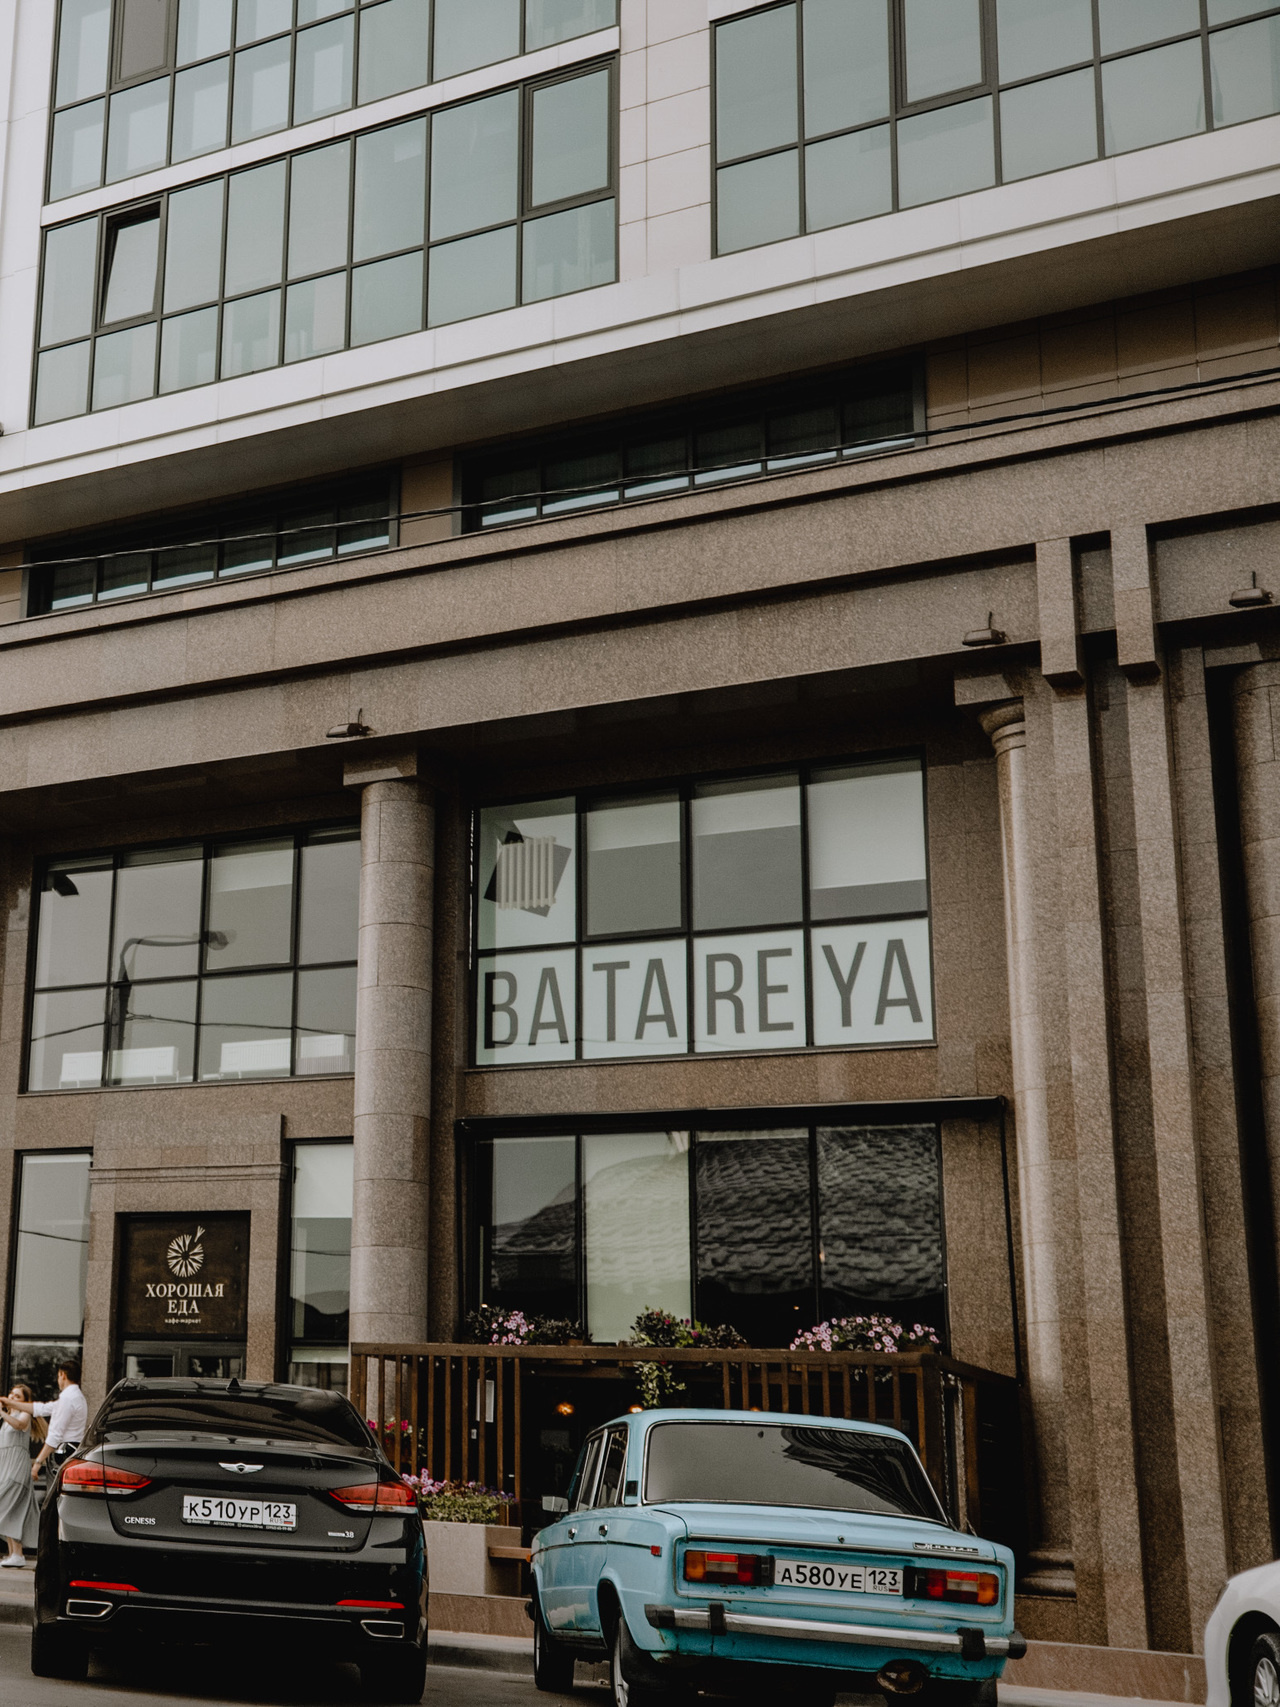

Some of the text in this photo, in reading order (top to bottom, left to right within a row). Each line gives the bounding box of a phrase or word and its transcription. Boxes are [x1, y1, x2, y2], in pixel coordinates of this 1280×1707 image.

[483, 938, 924, 1051] BATAREYA
[145, 1283, 225, 1298] ХОРОШАЯ
[167, 1299, 200, 1316] ЕДА
[264, 1504, 291, 1519] 123
[124, 1516, 156, 1525] GENESIS
[868, 1570, 898, 1586] 123
